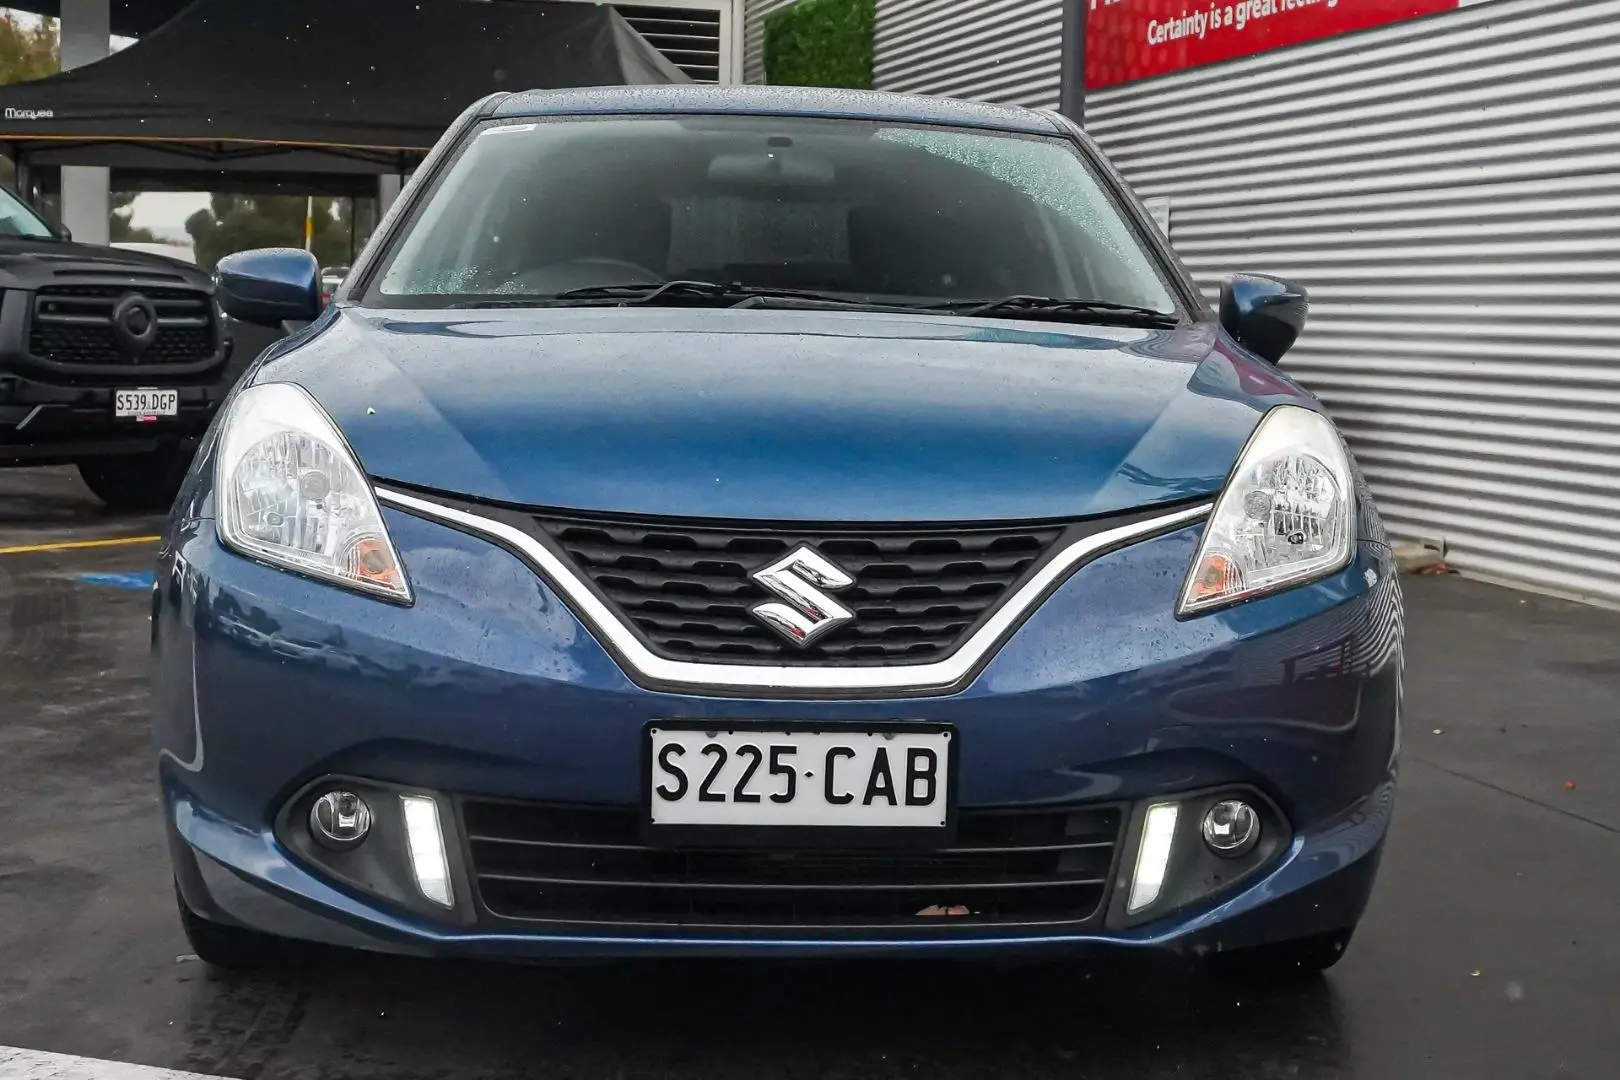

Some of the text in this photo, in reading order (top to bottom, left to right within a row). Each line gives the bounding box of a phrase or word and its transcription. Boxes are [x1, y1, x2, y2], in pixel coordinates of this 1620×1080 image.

[1147, 0, 1278, 45] Certainty is a great
